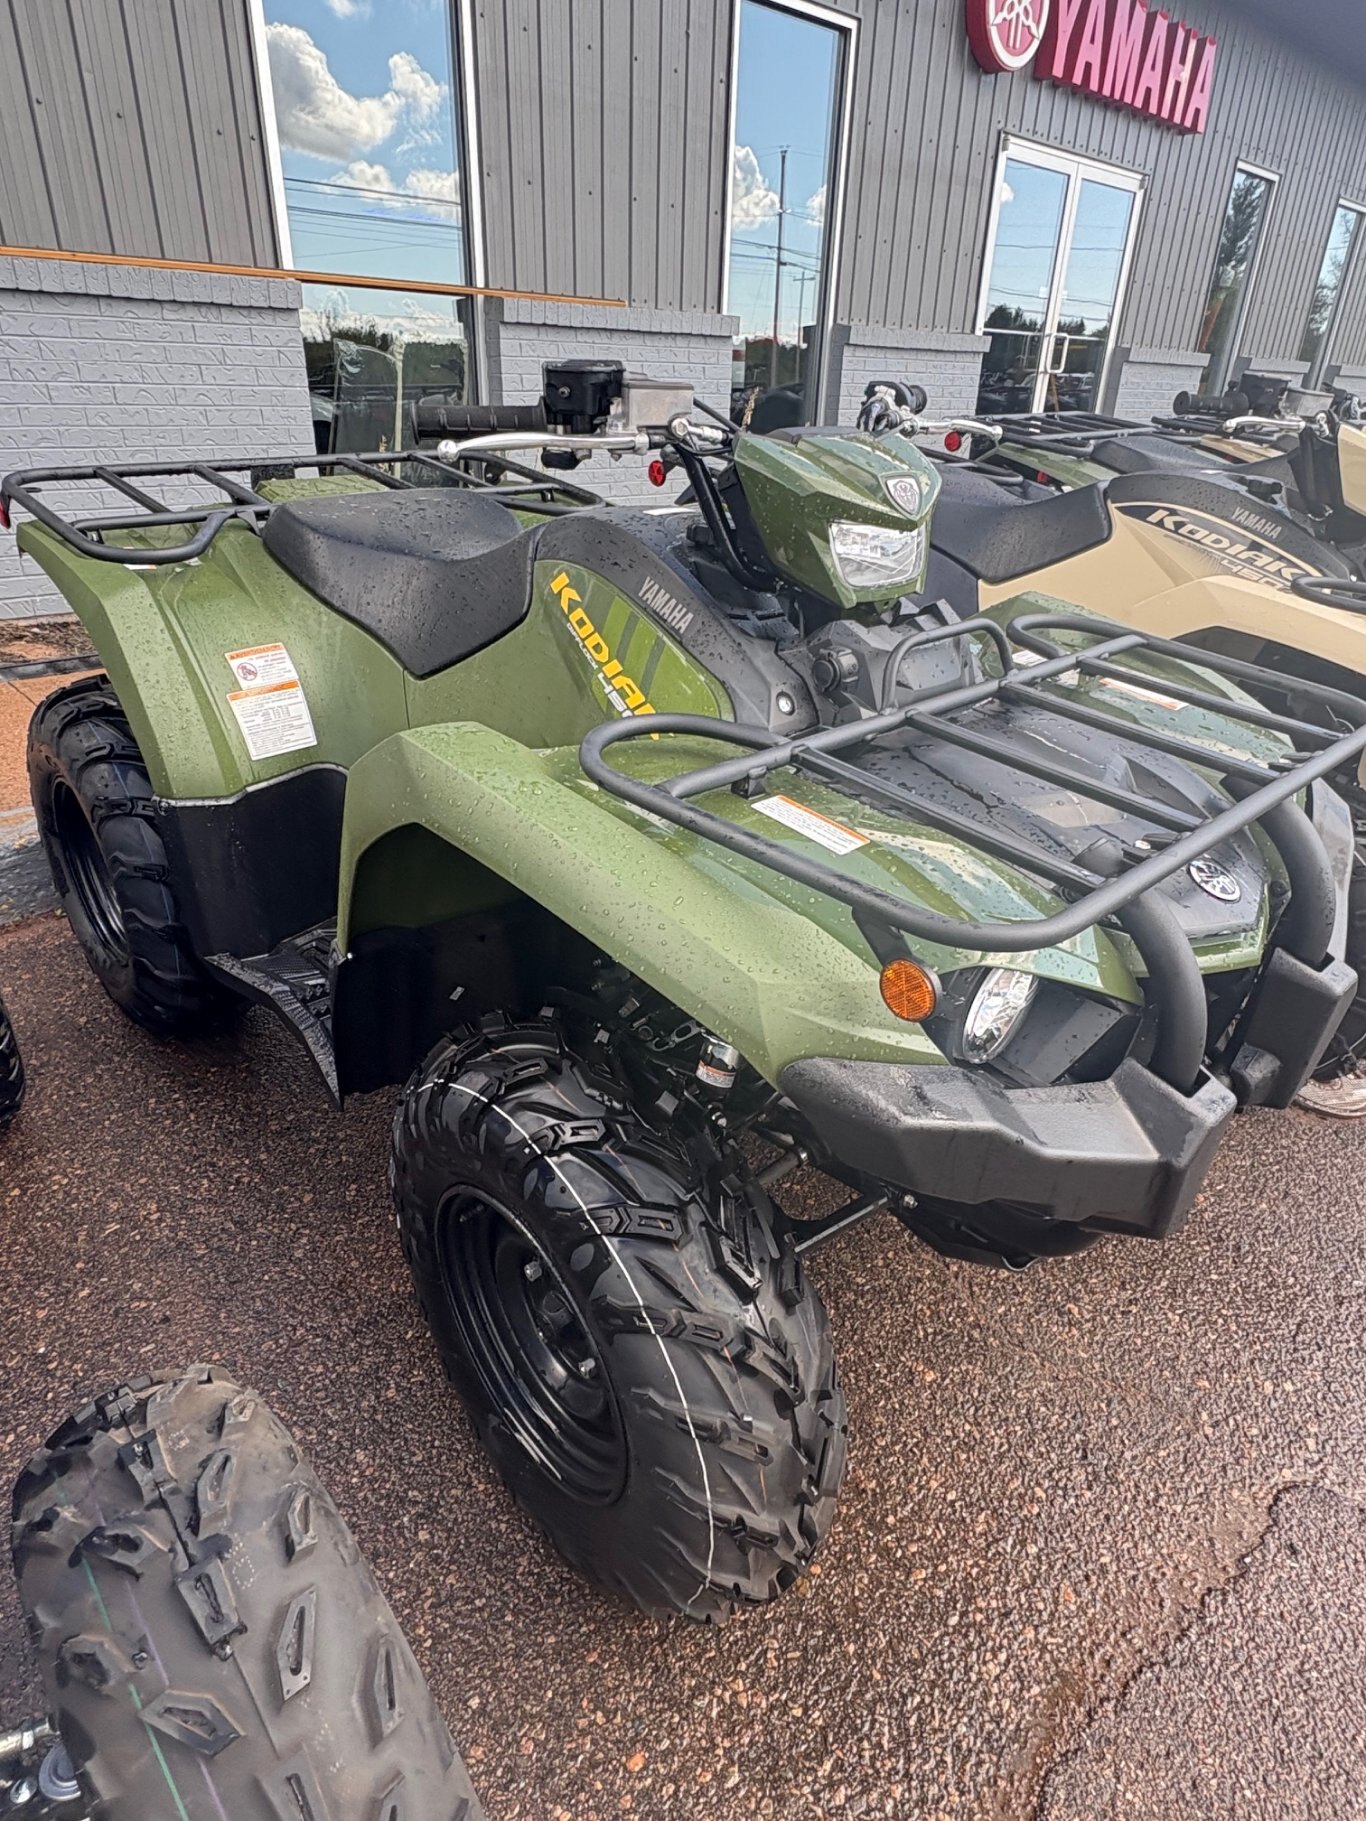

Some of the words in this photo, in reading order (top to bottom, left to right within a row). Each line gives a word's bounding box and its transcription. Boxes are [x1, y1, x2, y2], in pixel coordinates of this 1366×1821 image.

[1050, 0, 1217, 134] YAMAHA
[1145, 508, 1306, 581] KODIAK
[1230, 506, 1283, 540] YAMAHA
[637, 576, 695, 635] YAMAHA
